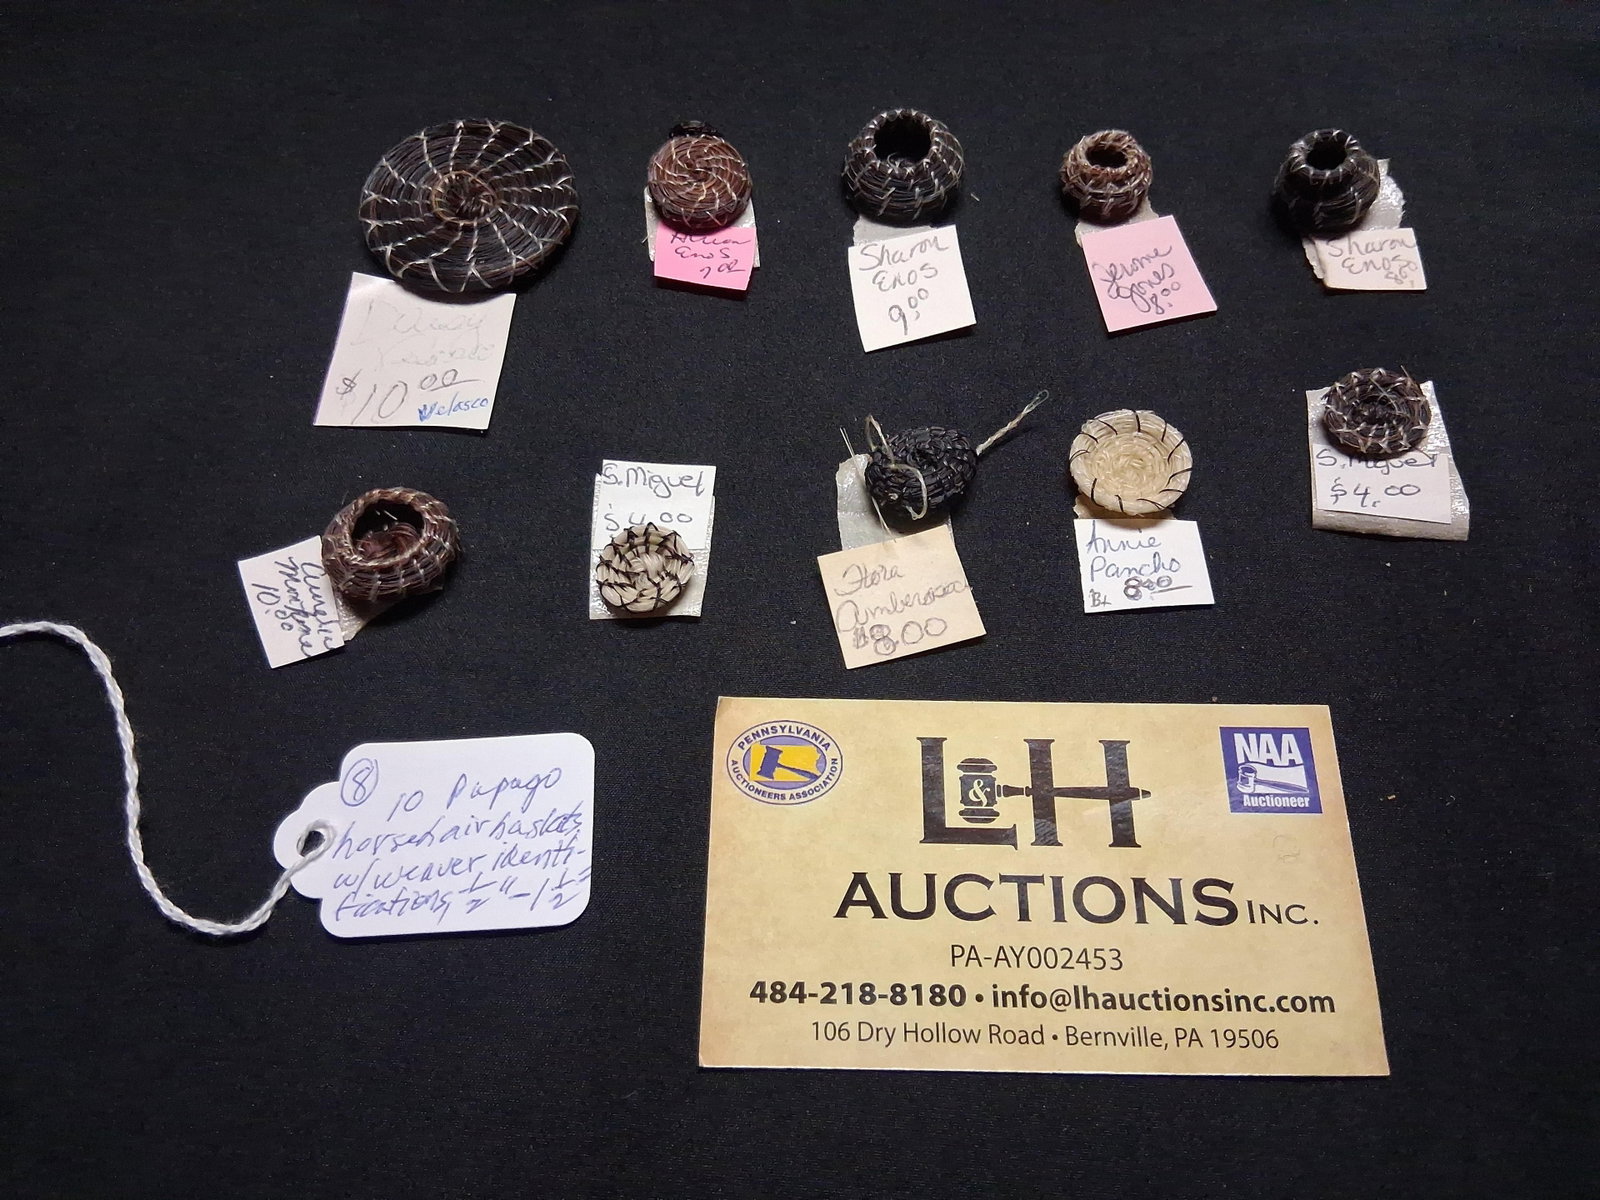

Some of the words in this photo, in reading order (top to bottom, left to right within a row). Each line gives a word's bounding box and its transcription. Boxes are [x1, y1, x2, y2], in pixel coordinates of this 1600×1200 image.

[858, 236, 949, 271] Sharon
[737, 724, 832, 751] PENNSYLVANIA
[1233, 732, 1304, 766] NAA
[730, 759, 787, 801] AUCTIONEERS
[788, 757, 839, 801] ASSOCIATION
[1242, 794, 1310, 808] Auctioneer
[833, 871, 1239, 927] AUCTIONS
[1246, 899, 1320, 926] INC.
[950, 944, 1124, 971] PA-AY002453
[749, 980, 967, 1007] 484-218-8180
[991, 983, 1336, 1014] info@lhauctionsinc.com
[811, 1021, 851, 1042] 106
[857, 1021, 896, 1048] Dry
[903, 1022, 981, 1044] Hollow
[988, 1024, 1046, 1045] Road
[1065, 1025, 1169, 1050] Bernville,
[1175, 1027, 1204, 1048] PA
[1210, 1028, 1280, 1049] 19506
